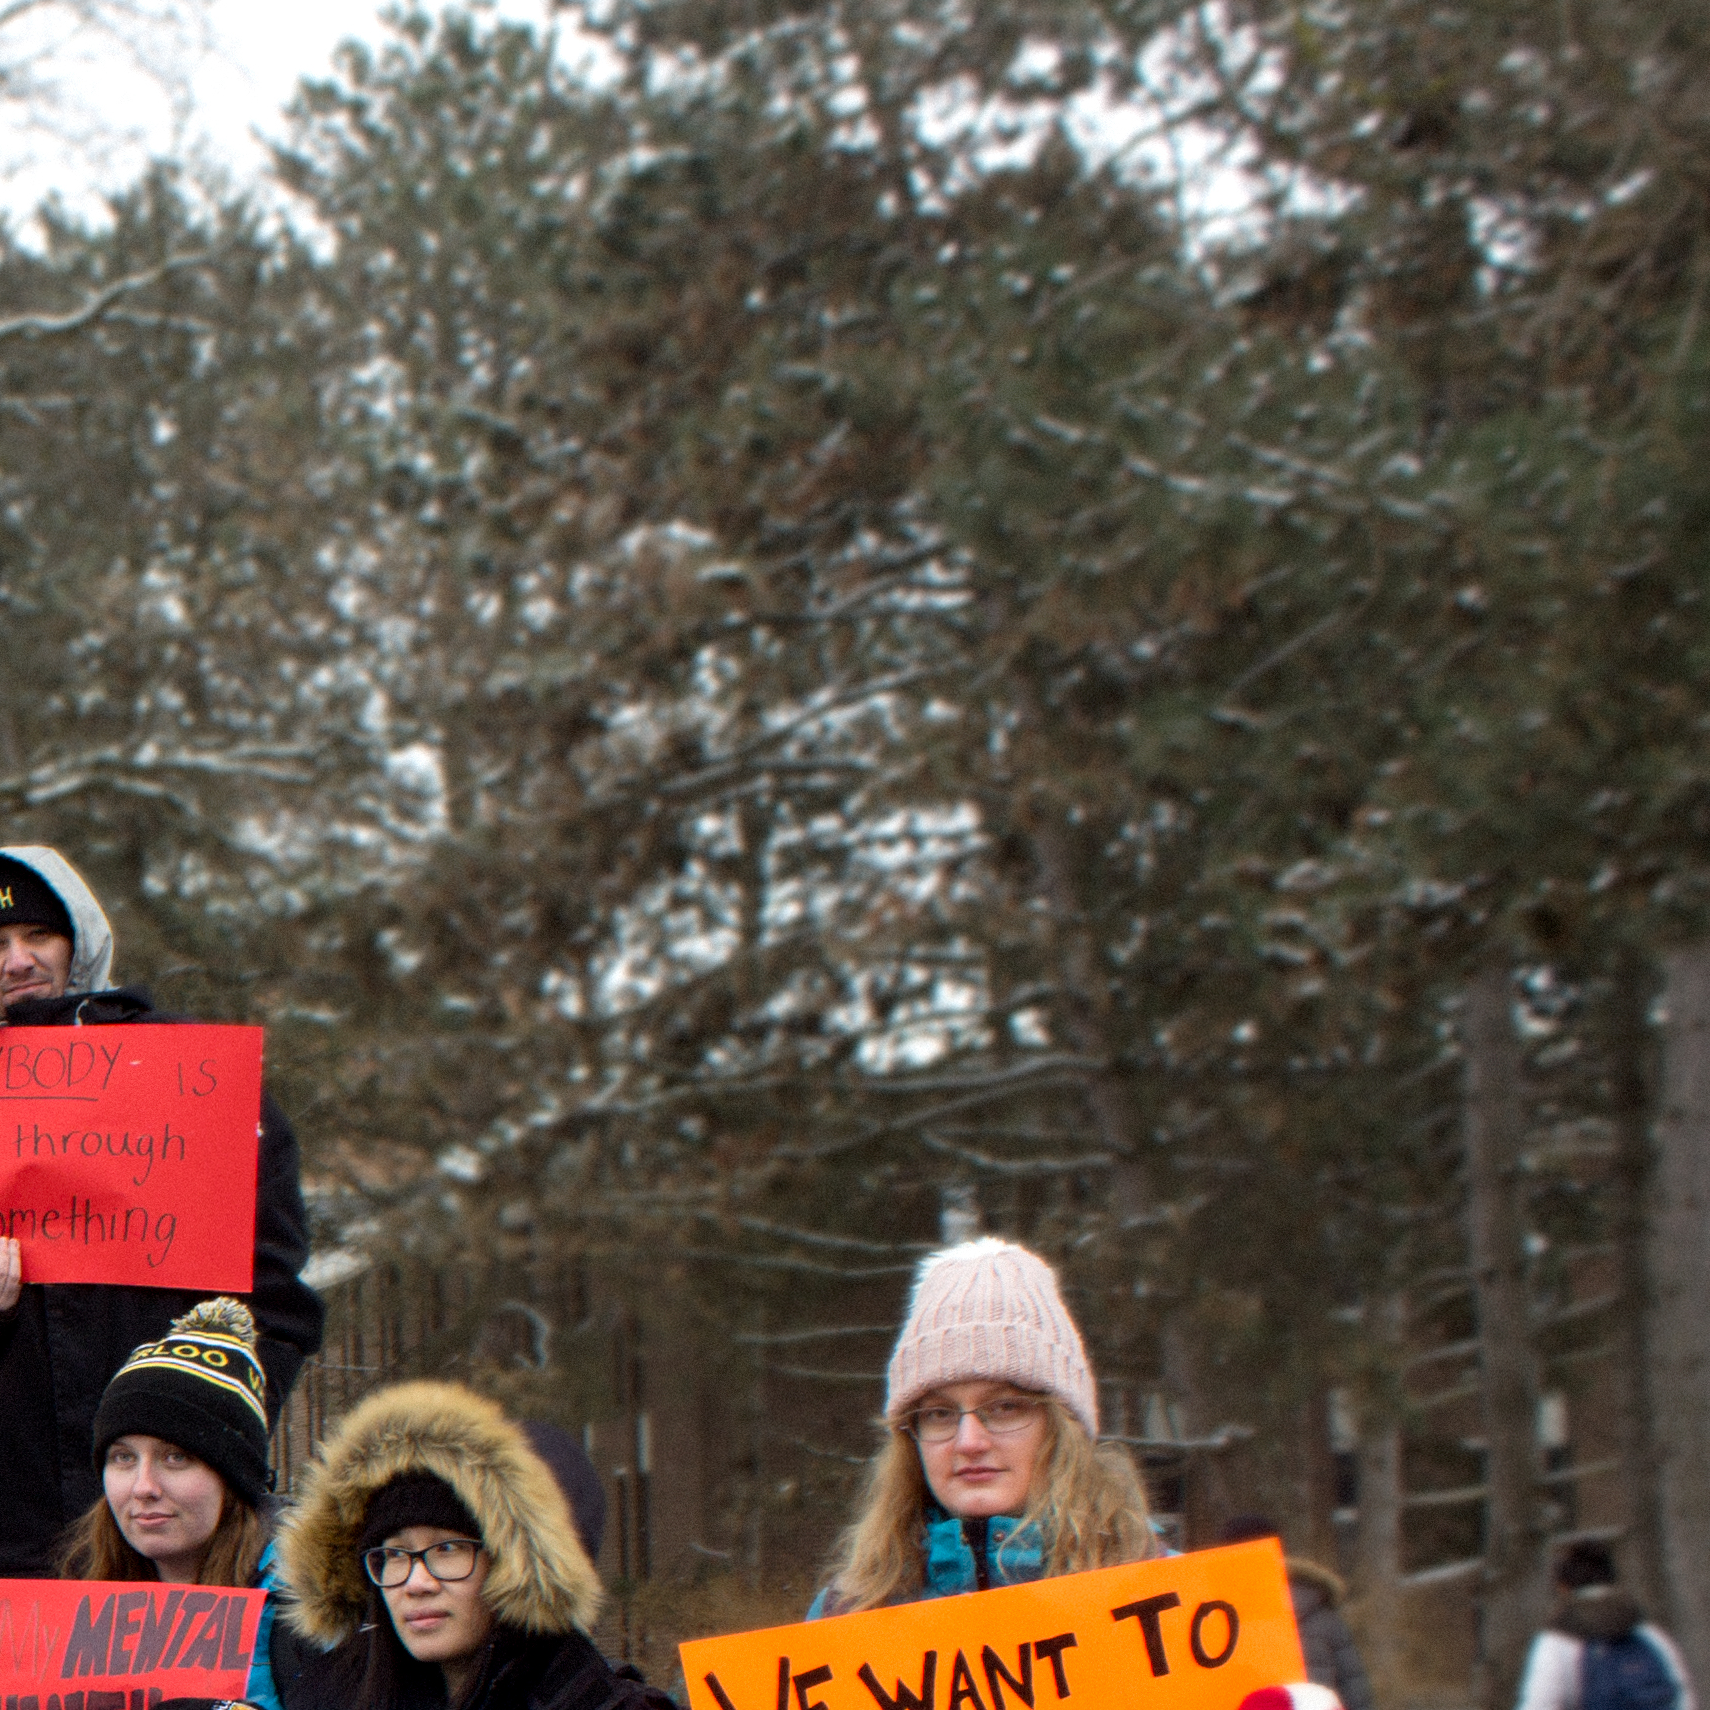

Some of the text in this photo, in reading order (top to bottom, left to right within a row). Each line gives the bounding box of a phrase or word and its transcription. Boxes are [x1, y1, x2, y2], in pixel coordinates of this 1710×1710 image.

[178, 1059, 217, 1096] IS
[15, 1124, 185, 1186] through
[61, 1590, 251, 1680] MENTAL
[1110, 1591, 1239, 1677] TO
